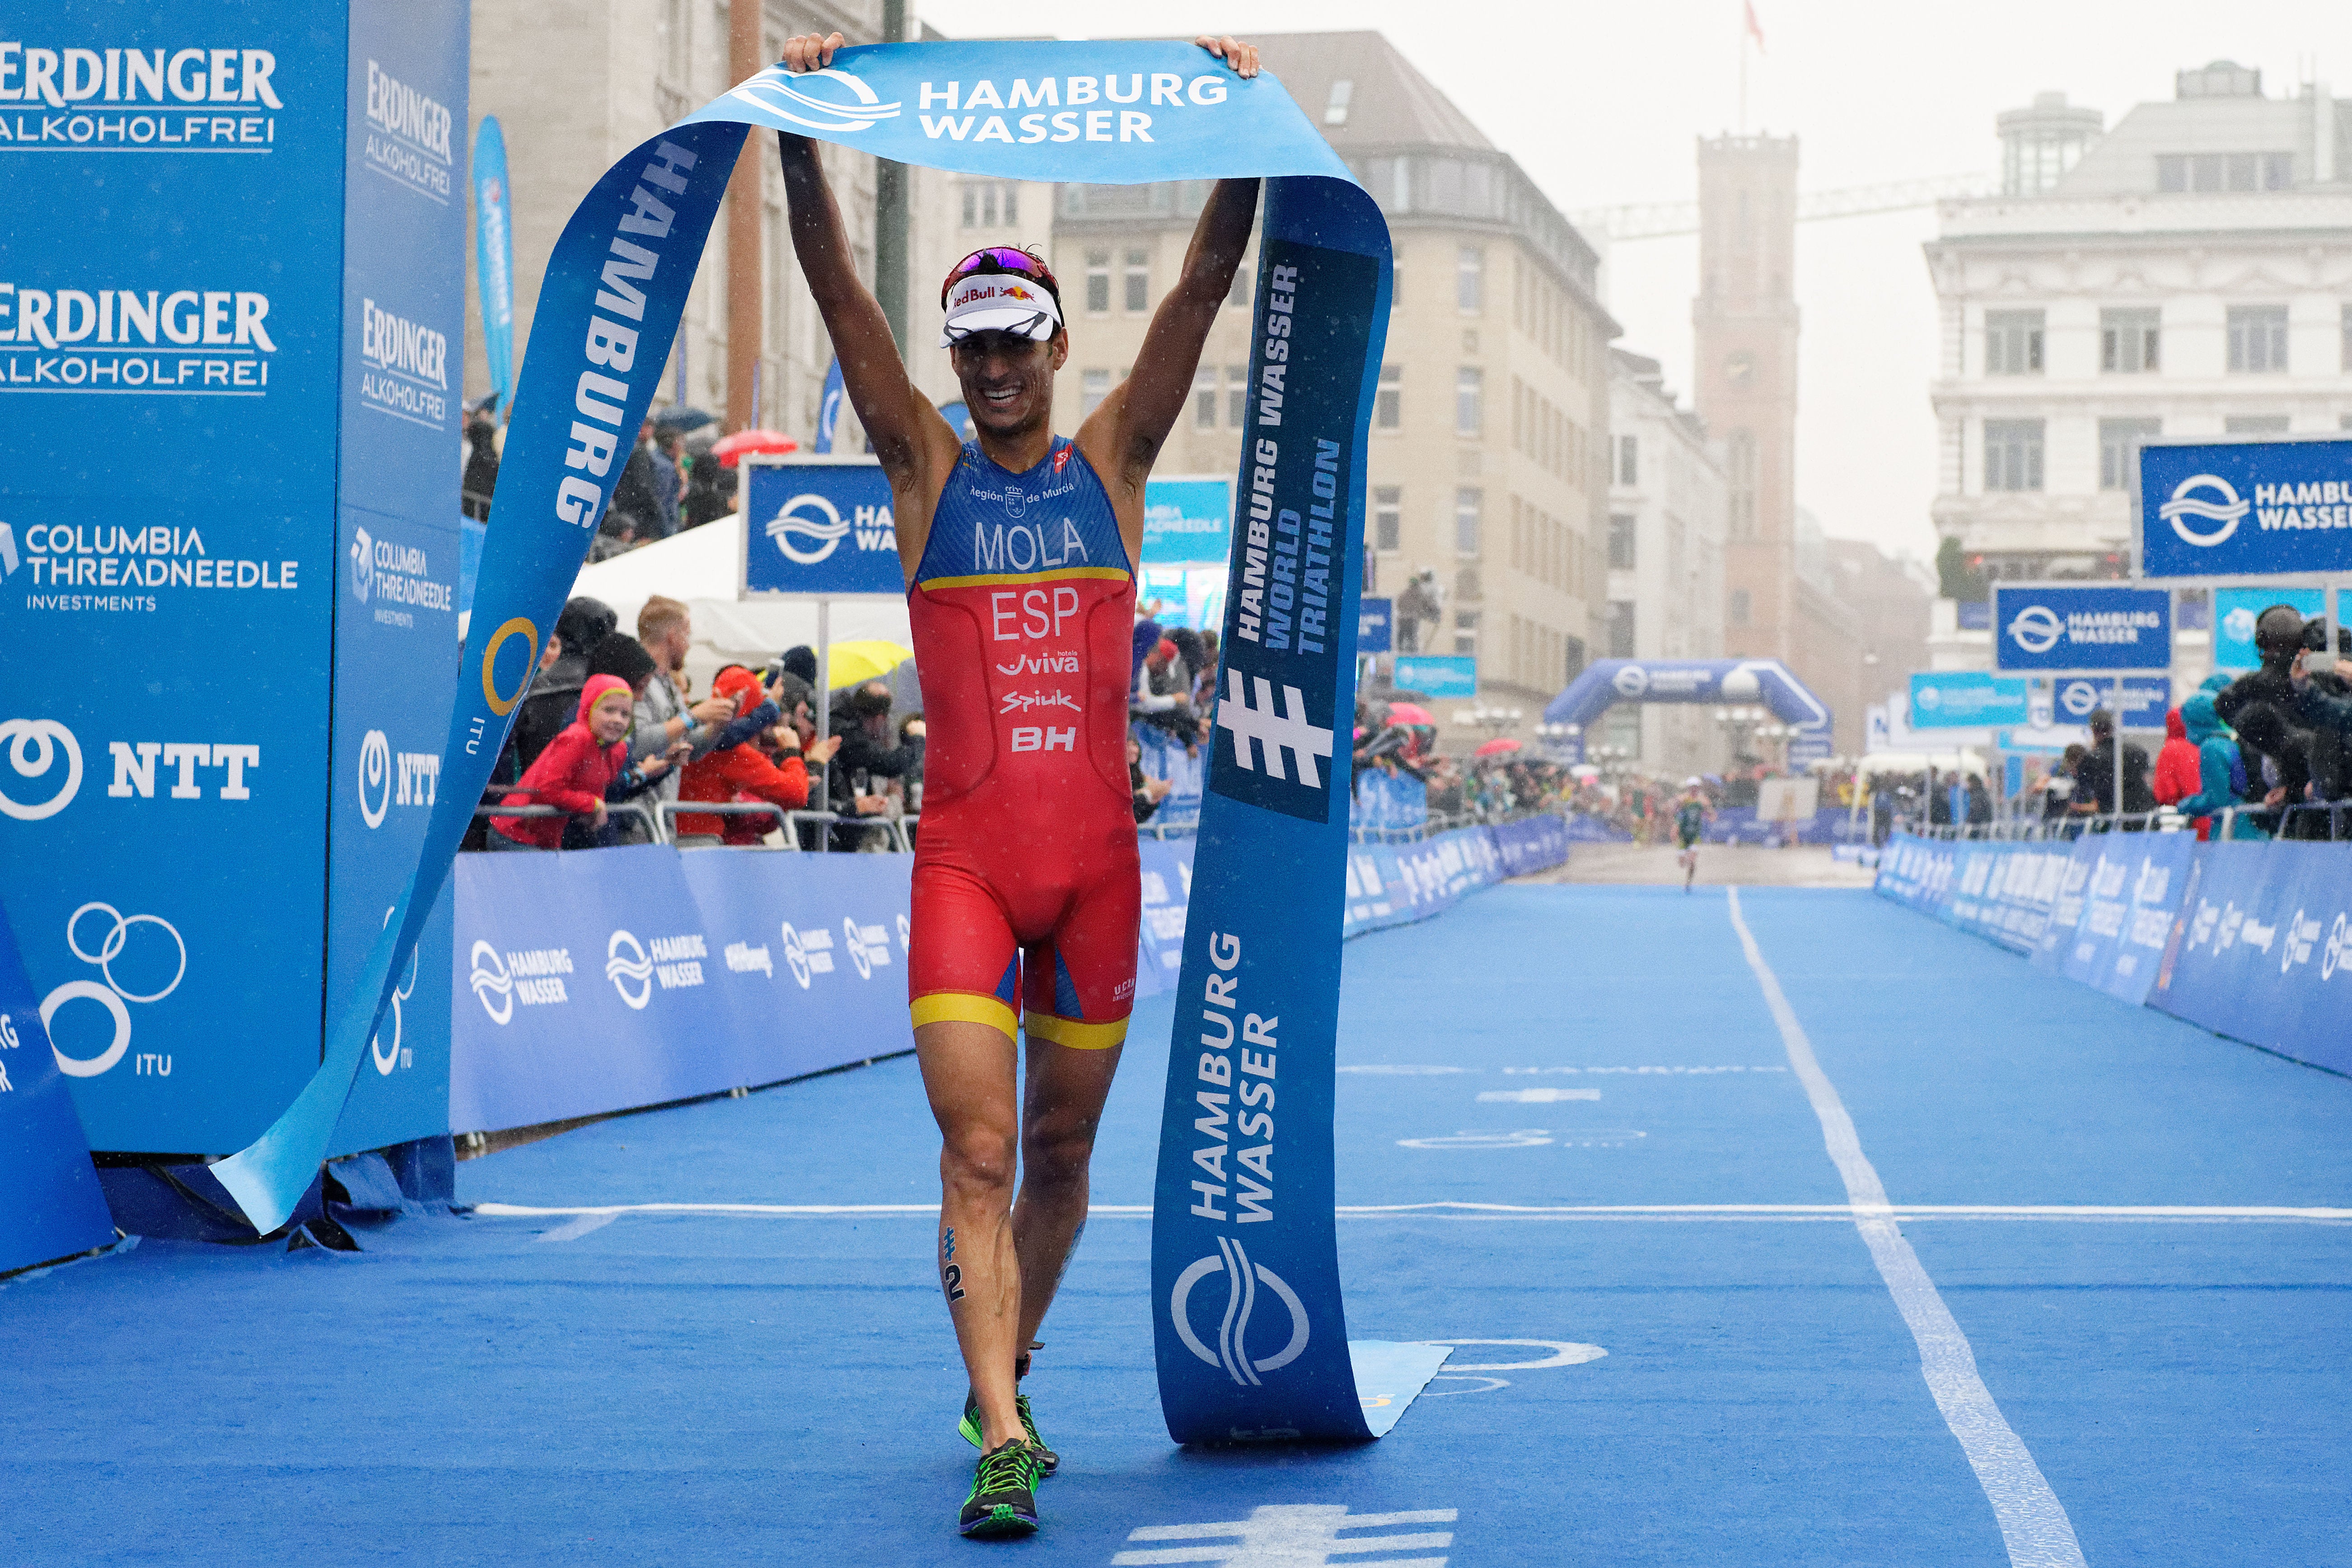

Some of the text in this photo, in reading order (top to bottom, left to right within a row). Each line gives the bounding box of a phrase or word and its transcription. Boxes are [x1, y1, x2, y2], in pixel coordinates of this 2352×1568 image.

[0, 42, 284, 109] ERDINGER
[920, 73, 1227, 109] HAMBURG
[366, 59, 452, 165] ERDINGER
[920, 111, 1155, 143] WASSER
[365, 134, 450, 196] ALKOHOLFREI
[971, 286, 995, 301] Bull
[363, 298, 447, 391] ERDINGER
[557, 140, 699, 529] HAMBURG
[0, 357, 267, 386] LKOHOLFREI
[362, 372, 445, 421] ALKOHOLFREI
[1238, 264, 1298, 643] HAMBURG WASSER
[970, 482, 1075, 503] Región de Murcia
[2257, 505, 2352, 530] WASSE
[26, 524, 205, 556] COLUMBIA
[375, 540, 427, 577] COLUMBIA
[974, 517, 1089, 571] MOLA
[1297, 438, 1340, 655] TRIATHLON
[26, 557, 298, 588] THREADNEEDLE
[1265, 508, 1301, 650] WORLD
[27, 594, 156, 611] INVESTMENTS
[375, 571, 451, 612] THREADNEEDLE
[991, 587, 1079, 641] ESP
[2067, 611, 2160, 627] HAMBURG
[2069, 628, 2138, 644] WASSER
[1000, 689, 1081, 714] Spiuk
[466, 717, 485, 755] ITU
[1011, 726, 1076, 752] BH
[108, 741, 259, 800] NTT
[396, 752, 439, 806] NTT
[506, 948, 574, 977] HAMBURG
[656, 961, 704, 989] WASSER
[515, 977, 568, 1006] WASSER
[136, 1053, 172, 1077] ITU
[1191, 931, 1240, 1221] HAMBURG
[1237, 1012, 1278, 1224] WASSER
[945, 1264, 966, 1303] 2
